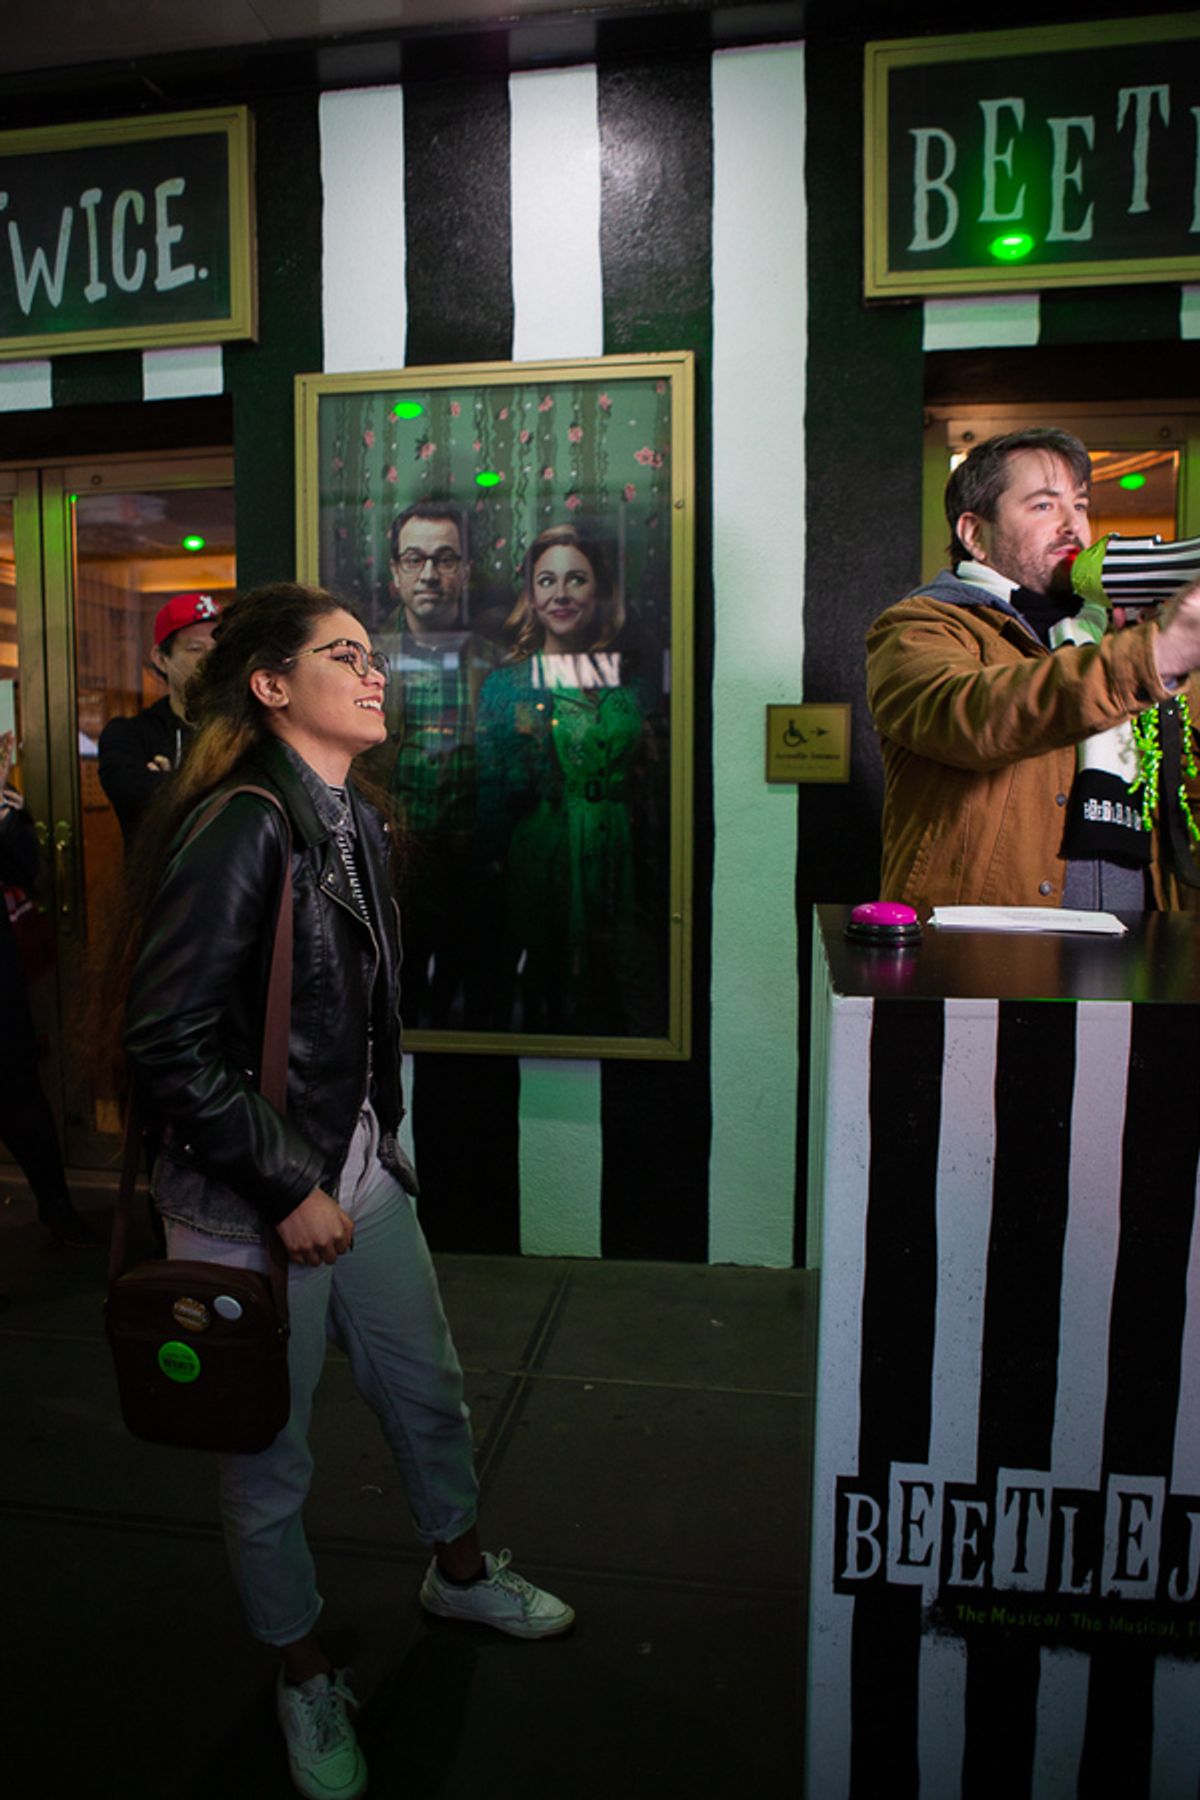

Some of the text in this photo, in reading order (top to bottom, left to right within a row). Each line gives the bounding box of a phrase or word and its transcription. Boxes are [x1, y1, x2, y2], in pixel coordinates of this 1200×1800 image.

[908, 84, 1200, 251] BEET
[0, 177, 208, 316] WICE.
[841, 1478, 1200, 1602] BEETLEJ
[955, 1603, 986, 1624] The
[1070, 1612, 1103, 1632] The
